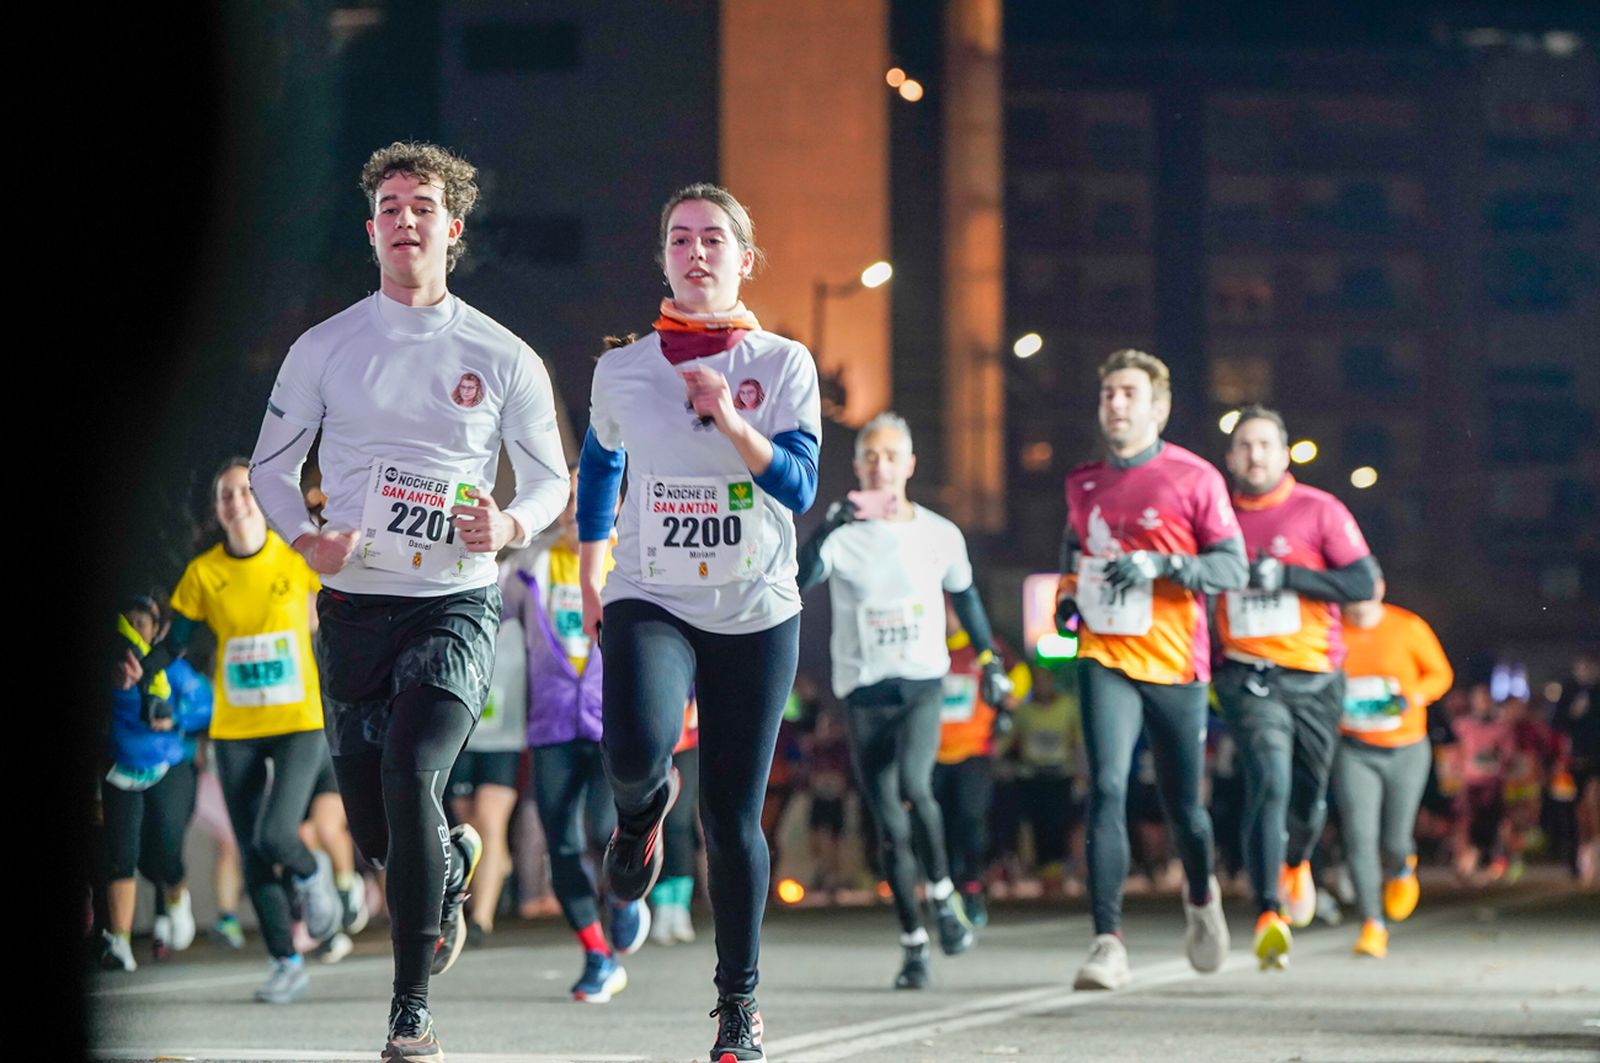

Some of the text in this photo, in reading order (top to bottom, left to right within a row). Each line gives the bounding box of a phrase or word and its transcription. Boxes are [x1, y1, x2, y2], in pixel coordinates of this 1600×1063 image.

[398, 475, 433, 491] NOCHE
[435, 482, 449, 495] DE
[382, 485, 446, 508] SAN ANTÓN
[667, 489, 718, 500] NOCHE DE
[653, 501, 676, 513] SAN
[678, 500, 718, 514] ANTÓN
[663, 515, 741, 548] 2200
[408, 539, 432, 551] Daniel
[689, 549, 716, 559] Miriam
